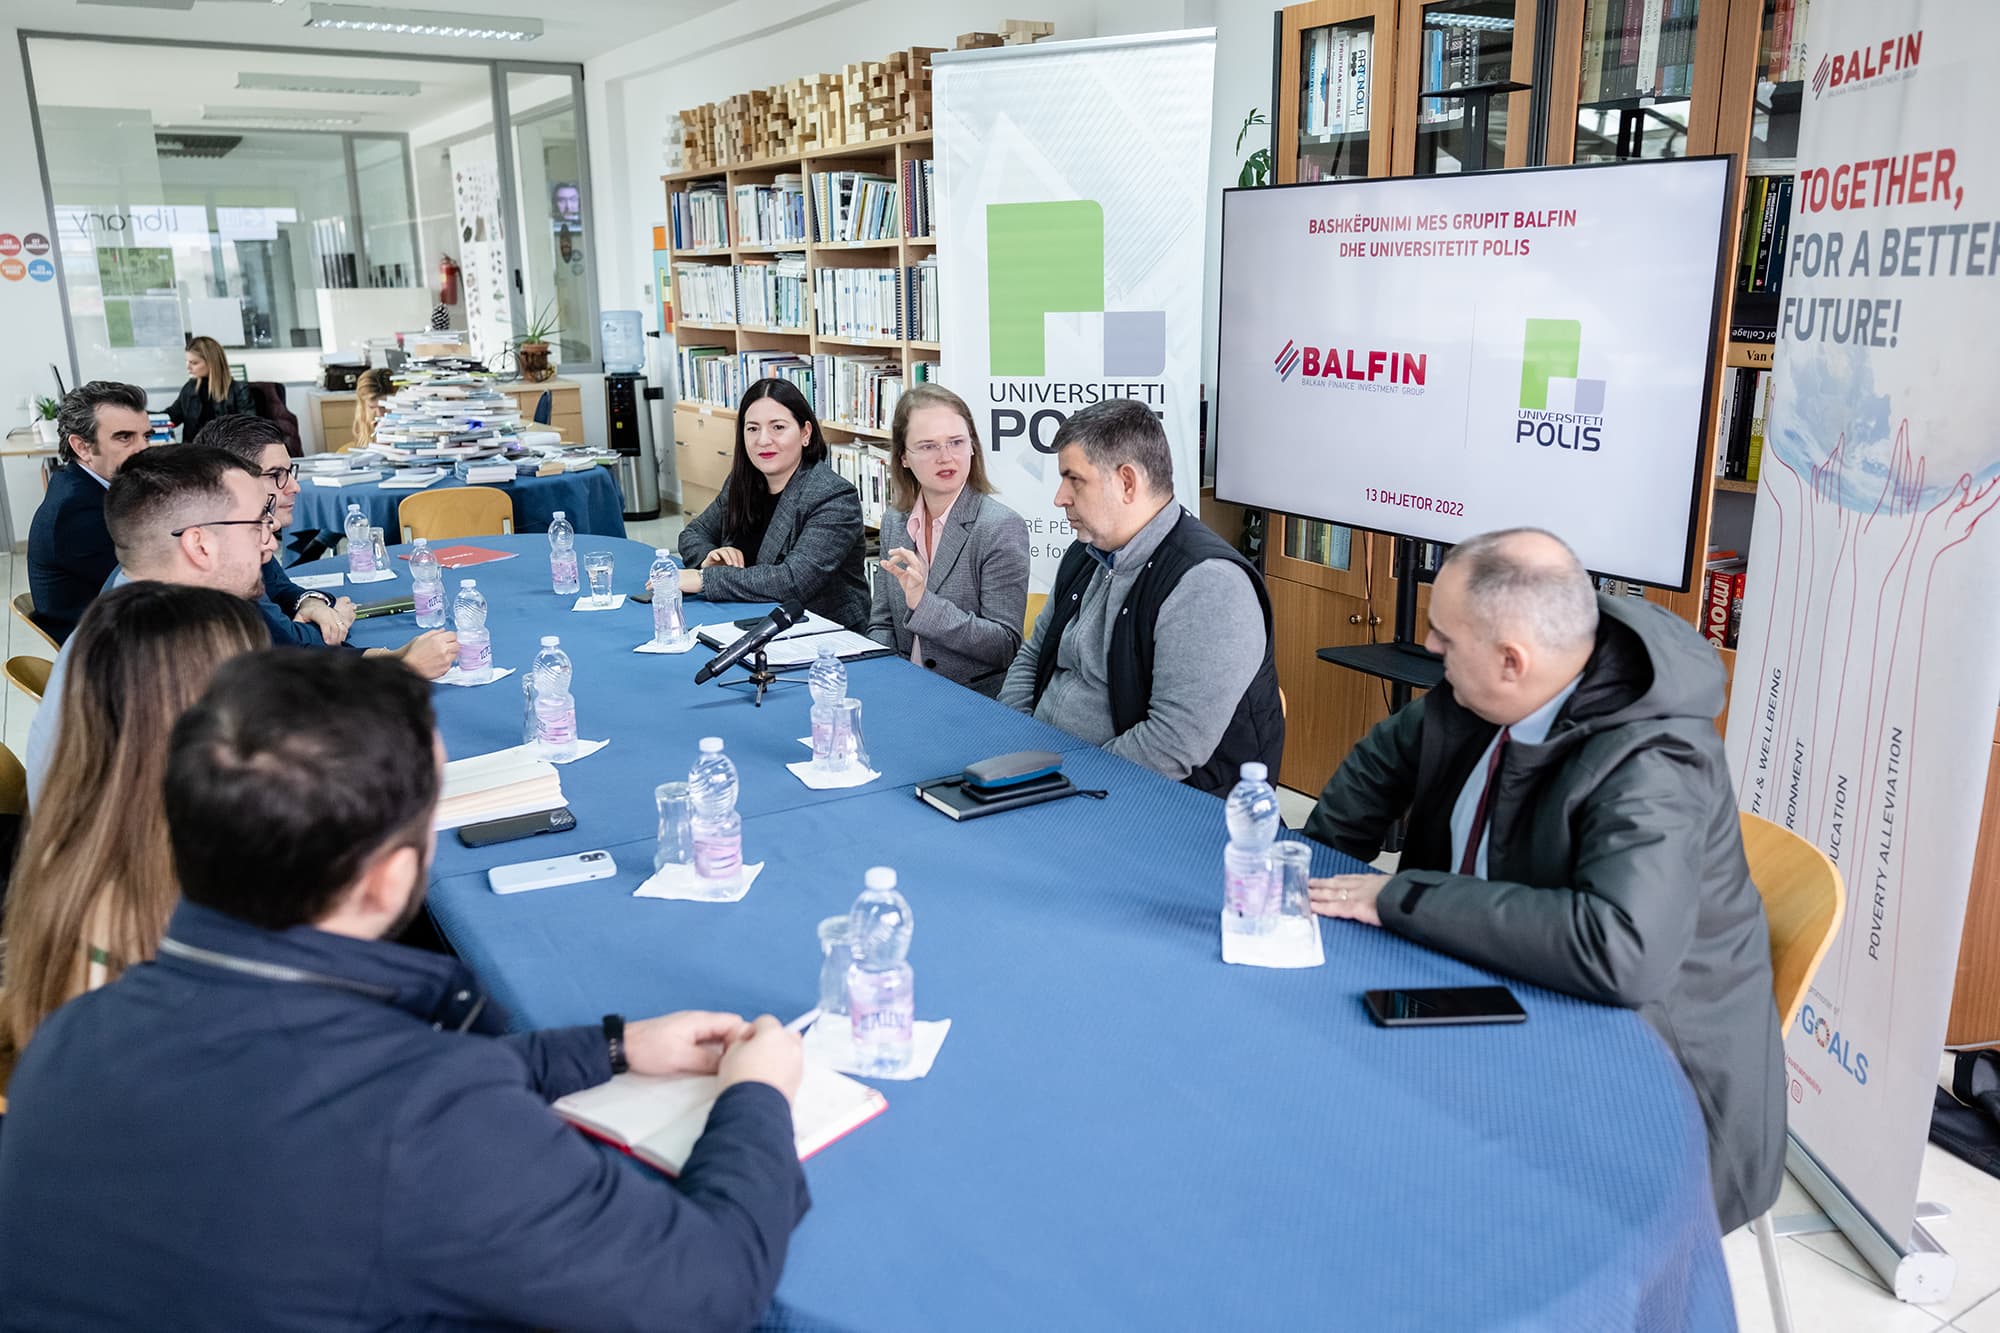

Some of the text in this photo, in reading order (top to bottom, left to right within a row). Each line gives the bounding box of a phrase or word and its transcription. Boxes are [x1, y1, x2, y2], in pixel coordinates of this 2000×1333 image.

[1830, 30, 1923, 88] BALFIN
[1799, 148, 1964, 214] TOGETHER,
[1309, 209, 1577, 234] BASHKËPUNIMI MES GRUPIT BALFIN
[1339, 239, 1530, 257] DHE UNIVERSITETIT POLIS
[1789, 231, 1844, 277] FOR
[1849, 230, 1870, 277] A
[1732, 328, 1776, 341] of Collage
[1781, 297, 1902, 348] FUTURE!
[1302, 346, 1427, 386] BALFIN
[1746, 350, 1767, 362] Van
[990, 382, 1164, 404] UNIVERSITETI
[1301, 377, 1425, 396] BALKAN FINANCE INVESTMENT GROUP
[1518, 409, 1603, 426] UNIVERSITETI
[1516, 420, 1602, 452] POLIS
[1366, 488, 1464, 517] 13 DHJETOR 2022
[1050, 518, 1074, 535] PË
[1759, 667, 1782, 770] WELLBEING
[1756, 777, 1765, 789] &
[1829, 774, 1848, 866] UCATION
[1868, 727, 1903, 961] POVERTY ALLEVIATION
[1802, 1004, 1869, 1085] GOALS
